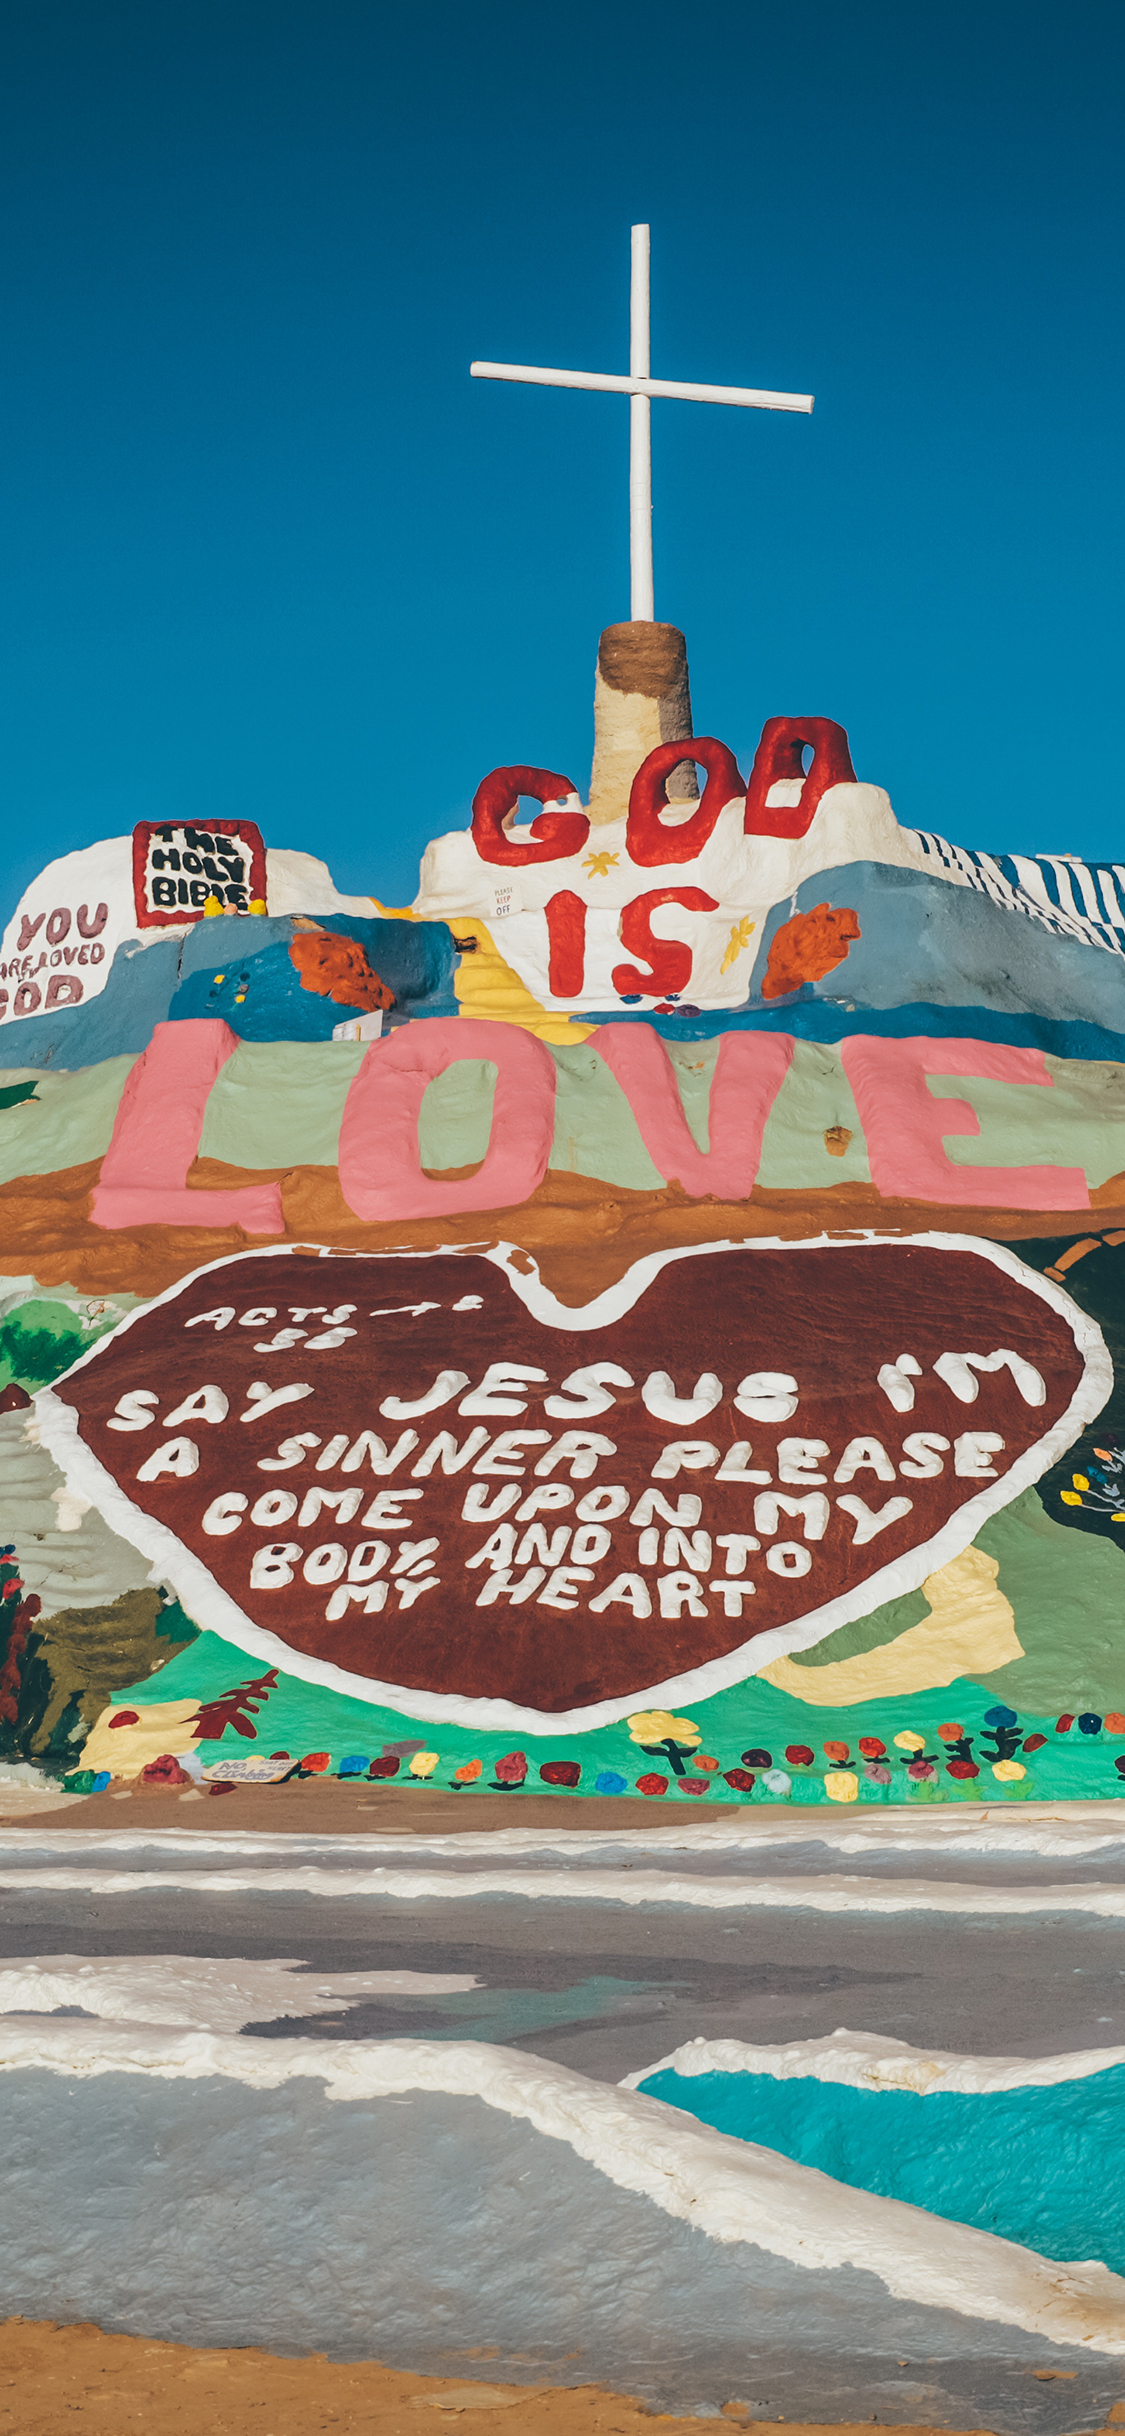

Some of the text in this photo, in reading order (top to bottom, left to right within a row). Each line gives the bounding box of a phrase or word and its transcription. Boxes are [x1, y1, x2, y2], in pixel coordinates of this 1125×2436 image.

[471, 716, 858, 868] GOD
[152, 848, 244, 883] HOLY
[155, 824, 239, 856] THE
[494, 886, 514, 896] PLEASE
[496, 895, 511, 904] KEEP
[496, 904, 511, 916] OFF
[17, 902, 108, 952] YOU
[543, 886, 720, 998] IS
[38, 942, 105, 971] LOVED
[89, 1017, 1092, 1235] LOVE
[184, 1304, 358, 1331] ACTS
[106, 1382, 315, 1432] SAY
[379, 1361, 799, 1426] JESUS
[136, 1425, 1006, 1486] A SINNER PLEASE
[201, 1482, 914, 1545] COME UPON MY
[464, 1522, 612, 1573] AND
[638, 1526, 812, 1578] INTO
[325, 1565, 757, 1621] MY HEART
